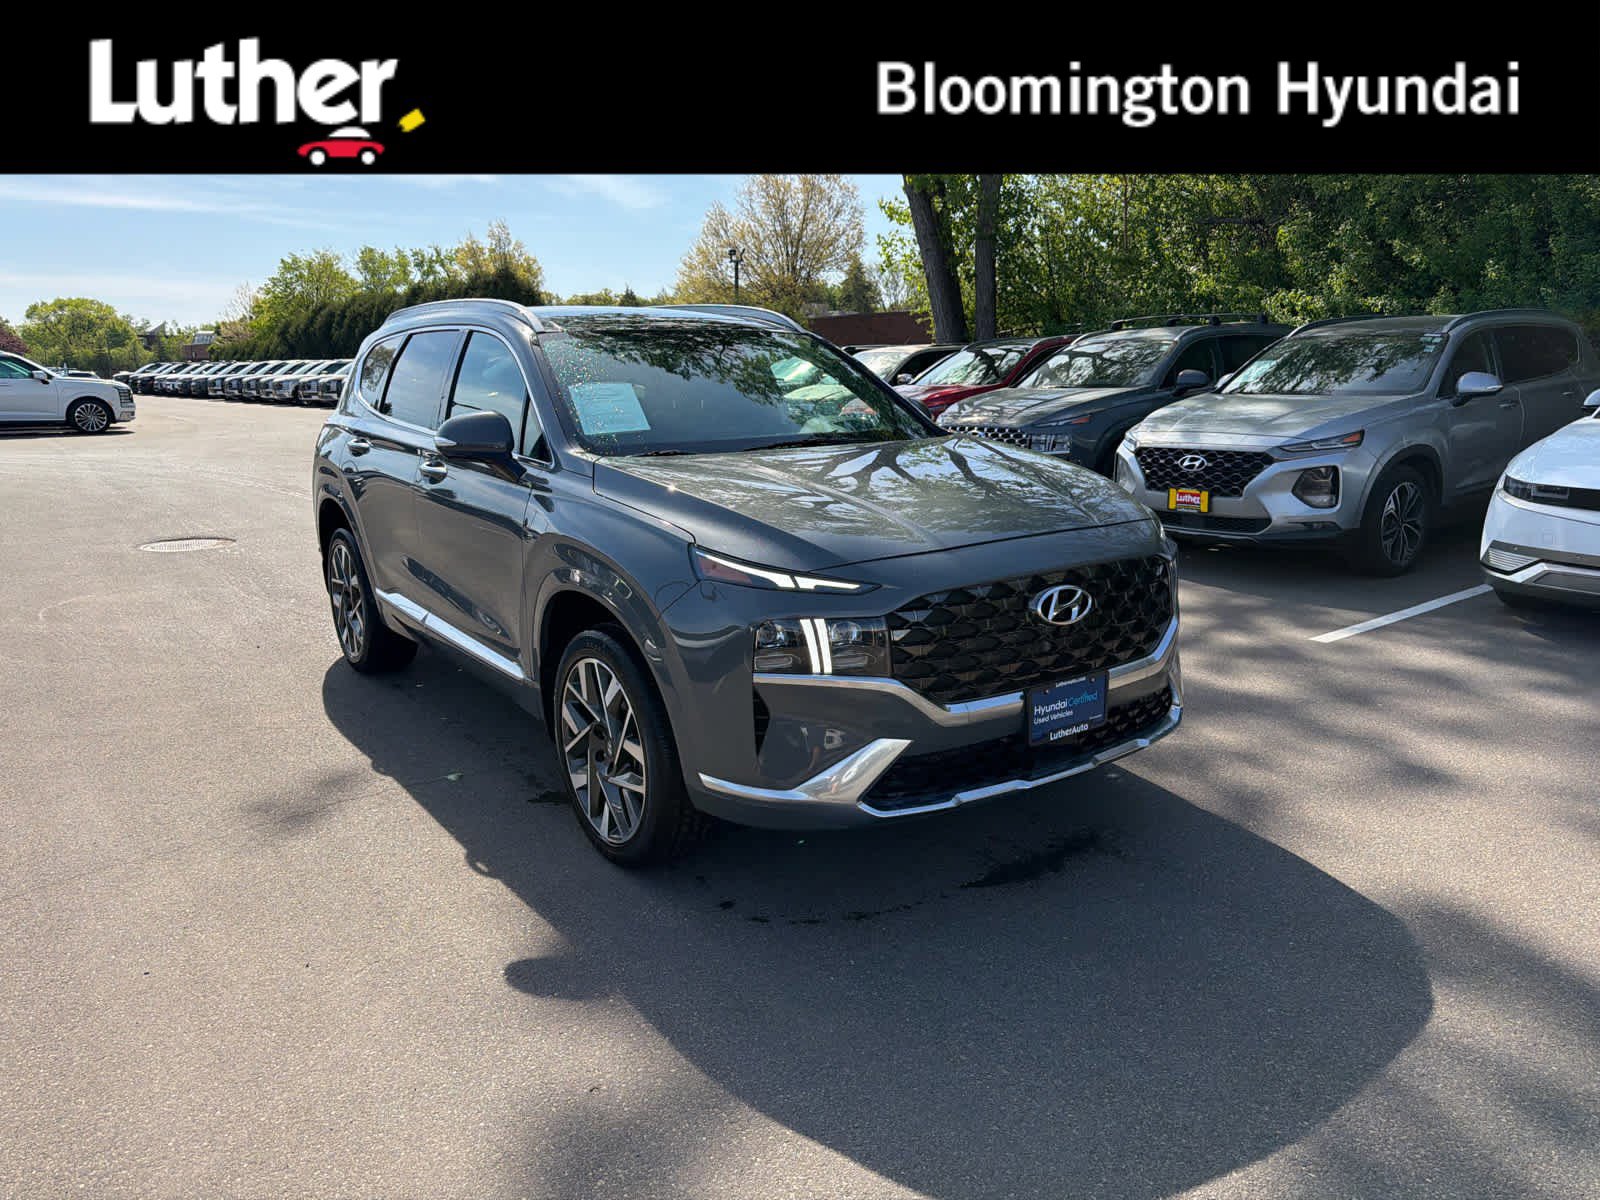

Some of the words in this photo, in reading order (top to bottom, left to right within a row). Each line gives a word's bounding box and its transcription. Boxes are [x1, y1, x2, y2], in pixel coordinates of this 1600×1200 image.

[1034, 699, 1067, 715] Hyundai
[1068, 690, 1098, 706] Certified
[1033, 715, 1049, 725] Used
[1050, 710, 1074, 721] Vehicles
[1049, 723, 1089, 740] LutherAuto
